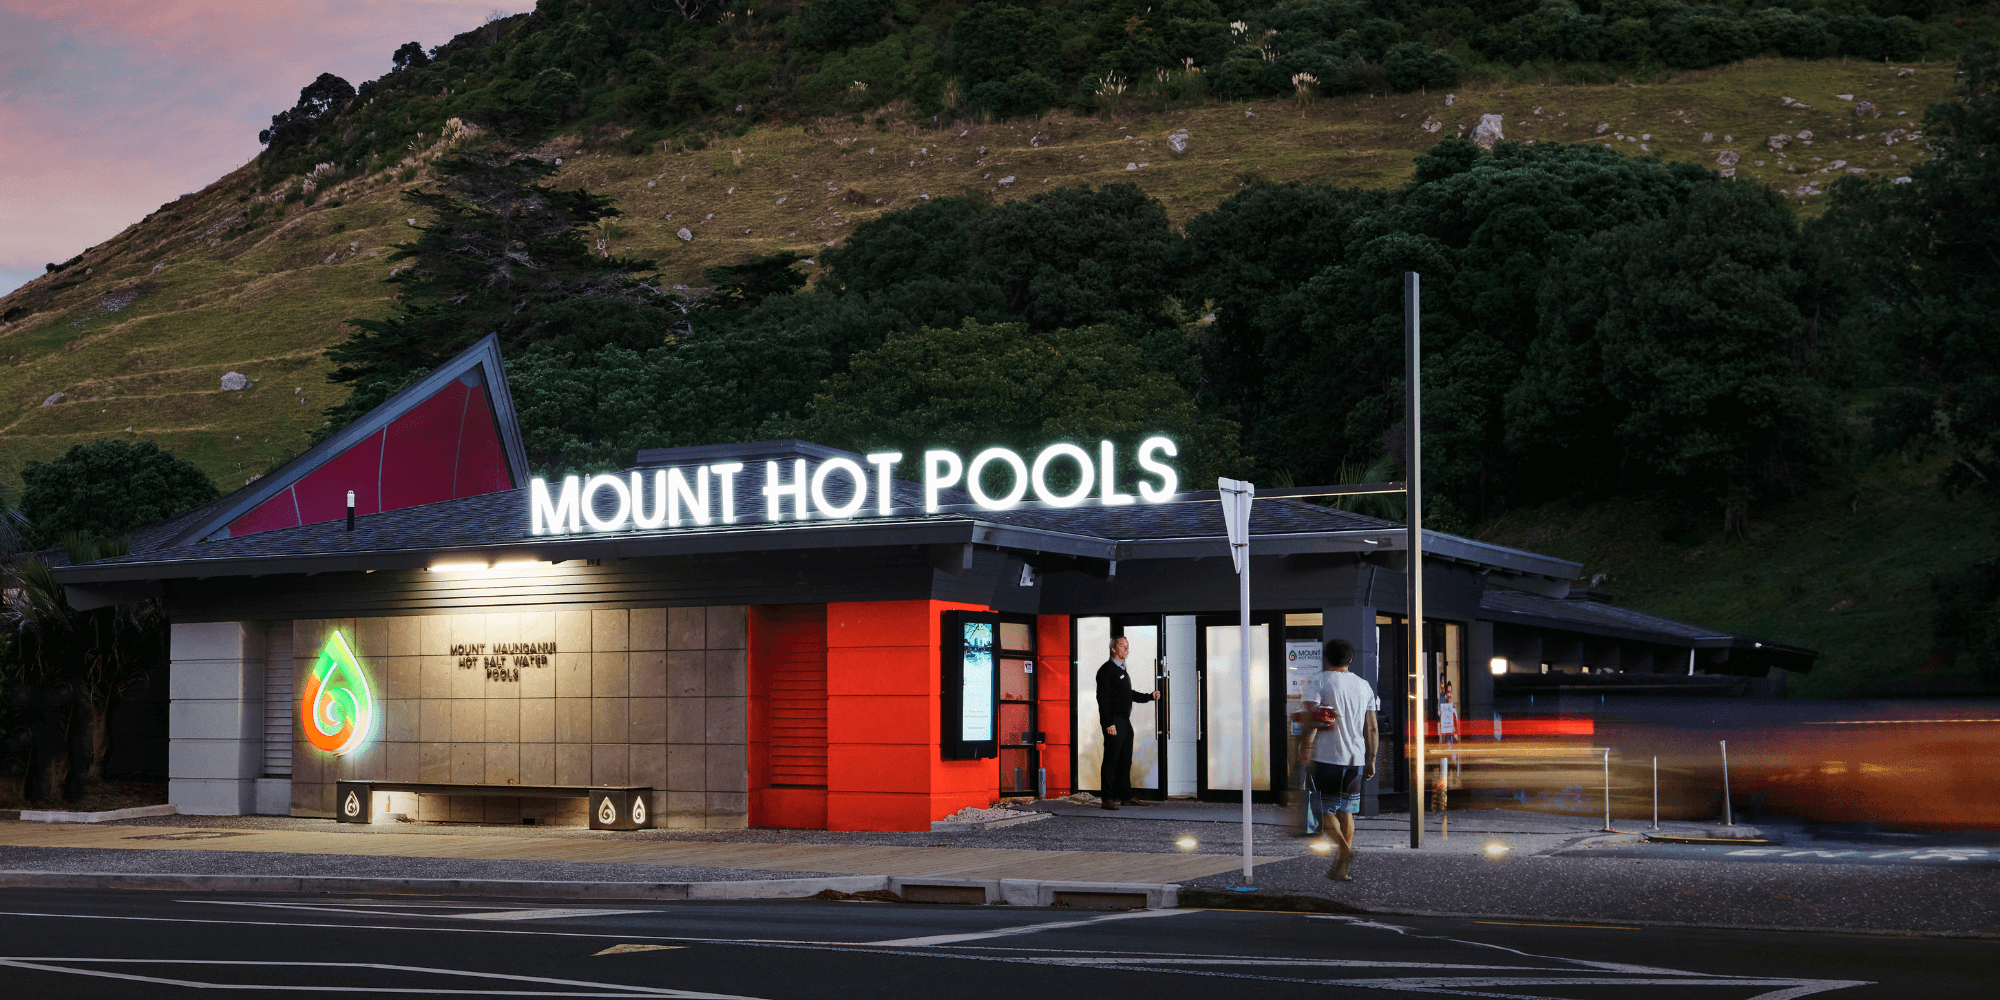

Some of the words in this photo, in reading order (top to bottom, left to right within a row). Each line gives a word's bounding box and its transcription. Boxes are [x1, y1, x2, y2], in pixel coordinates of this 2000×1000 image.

[531, 463, 744, 535] MOUNT
[763, 452, 903, 521] HOT
[924, 436, 1178, 512] POOLS
[450, 643, 486, 656] MOUNT
[492, 641, 557, 655] MAUNGANUI
[458, 656, 479, 669] HOT
[484, 655, 507, 669] SALT
[512, 655, 548, 669] WATER
[486, 668, 519, 682] POOLS
